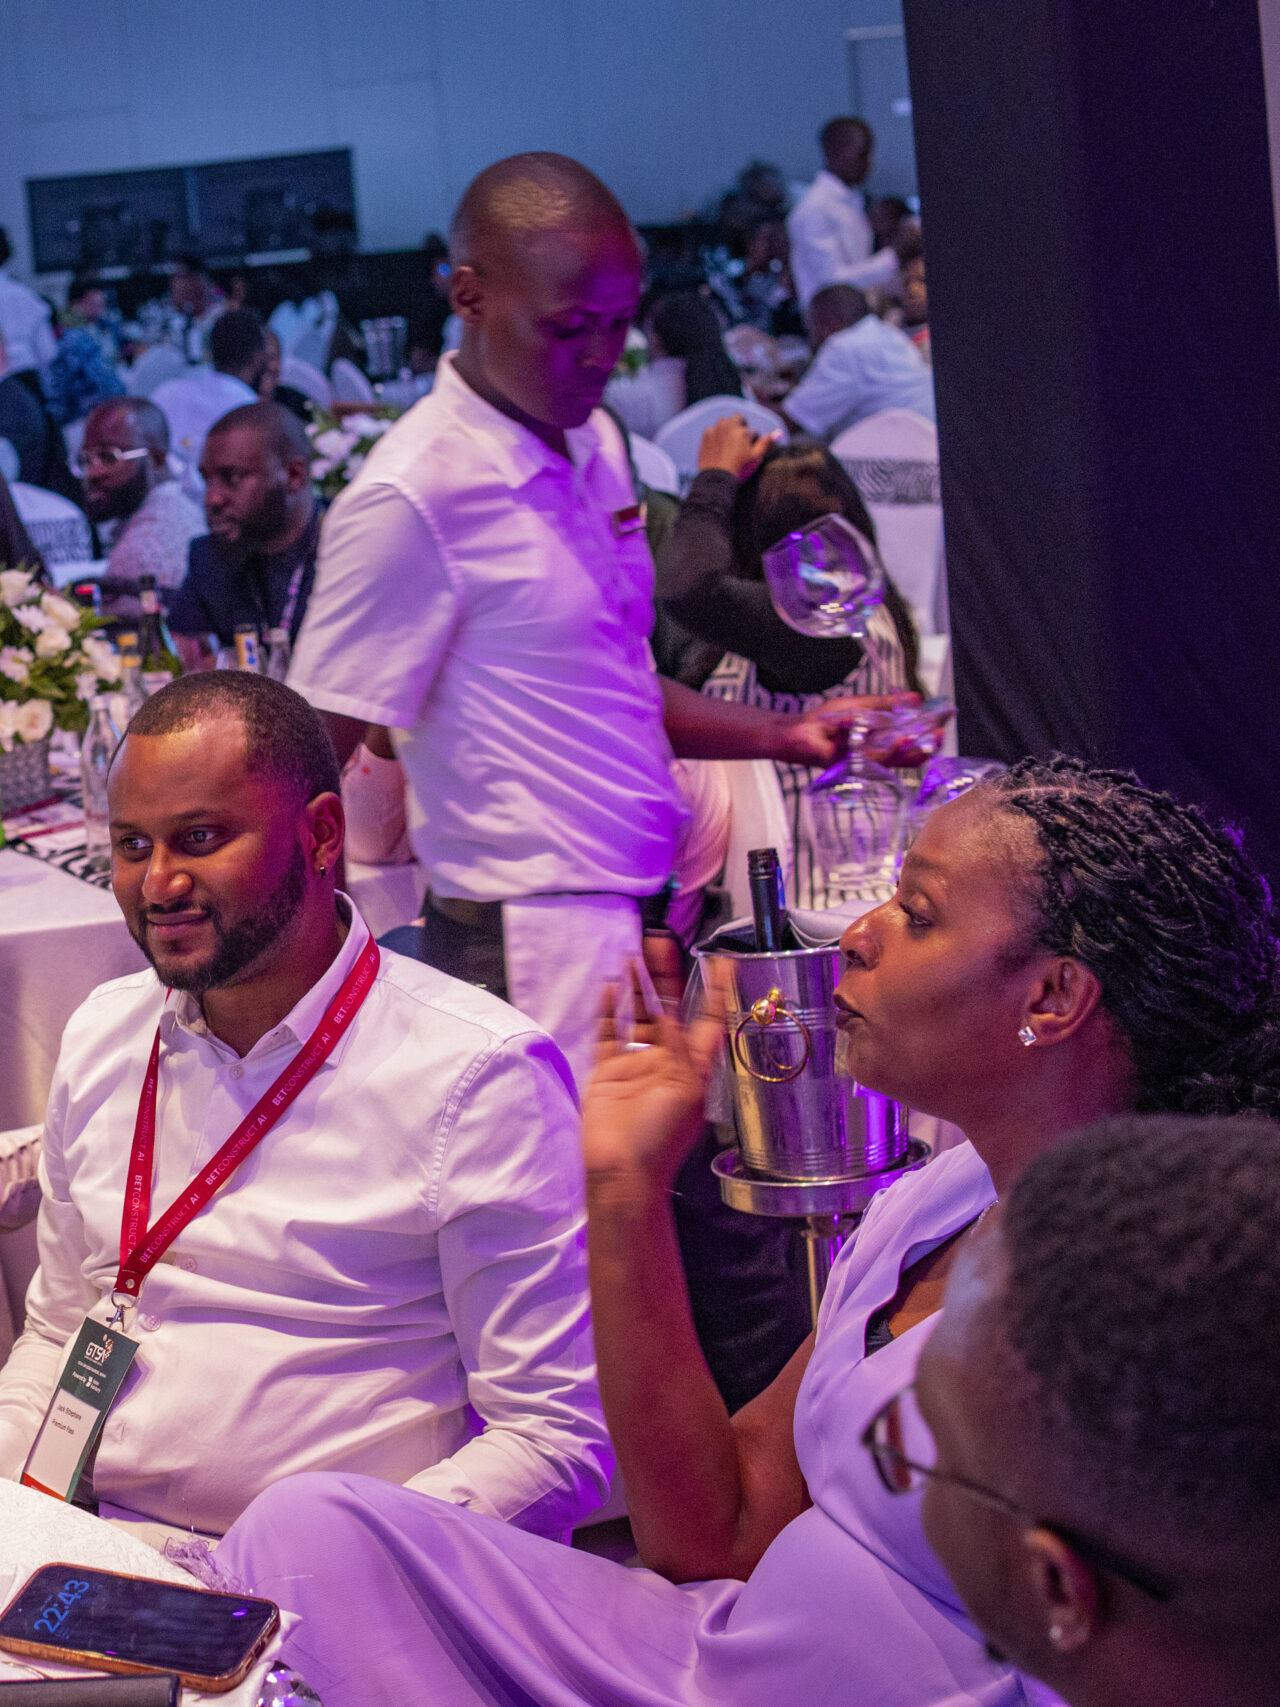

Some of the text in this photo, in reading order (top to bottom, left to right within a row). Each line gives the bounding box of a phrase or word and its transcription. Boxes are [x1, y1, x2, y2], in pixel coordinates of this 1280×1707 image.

[272, 1032, 331, 1106] BETCONSTRUCT AI
[137, 1151, 145, 1161] AI
[205, 1114, 267, 1185] BETCONSTRUCT AI
[128, 1174, 143, 1245] BETCONSTRUCT
[140, 1193, 200, 1263] BETCONSTRUCT AI
[33, 1579, 90, 1633] 22:43
